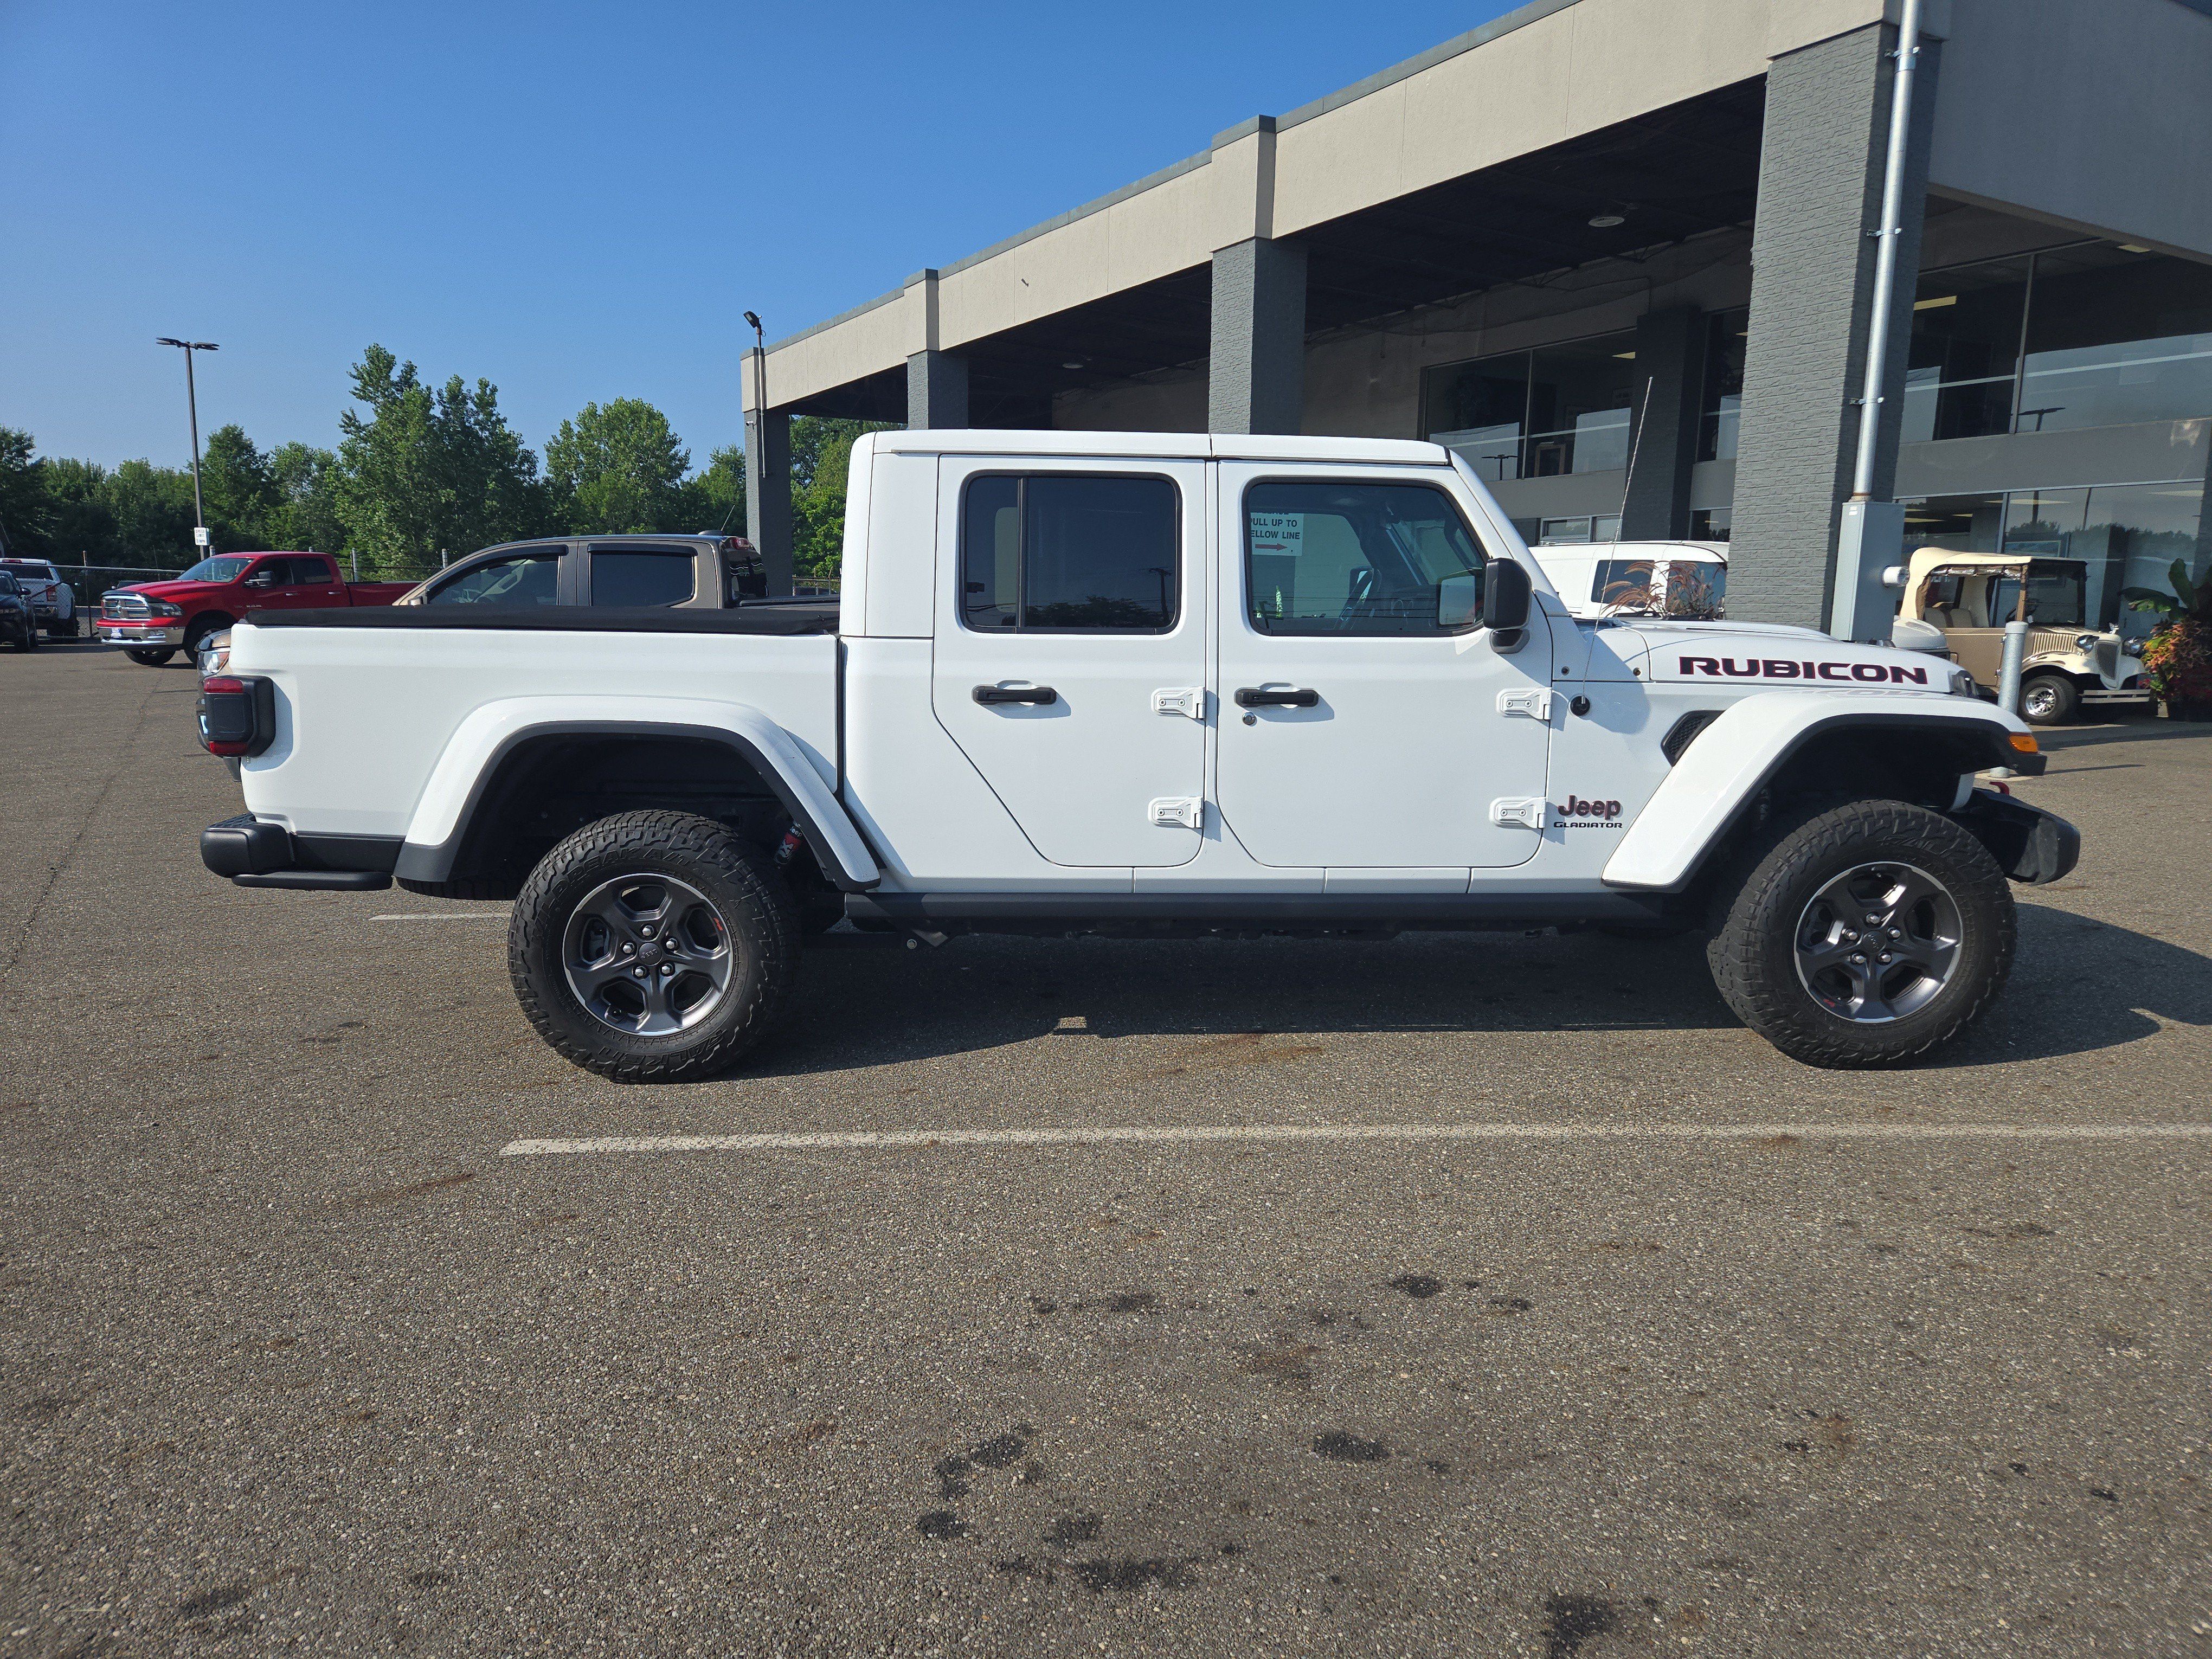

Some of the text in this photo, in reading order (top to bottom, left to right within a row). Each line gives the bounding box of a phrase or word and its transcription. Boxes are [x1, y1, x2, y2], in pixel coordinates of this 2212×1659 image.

[1251, 530, 1300, 539] ELLOW LINE
[1679, 656, 1928, 685] RUBICON
[1558, 795, 1621, 820] Jeep
[789, 826, 802, 837] Jeep
